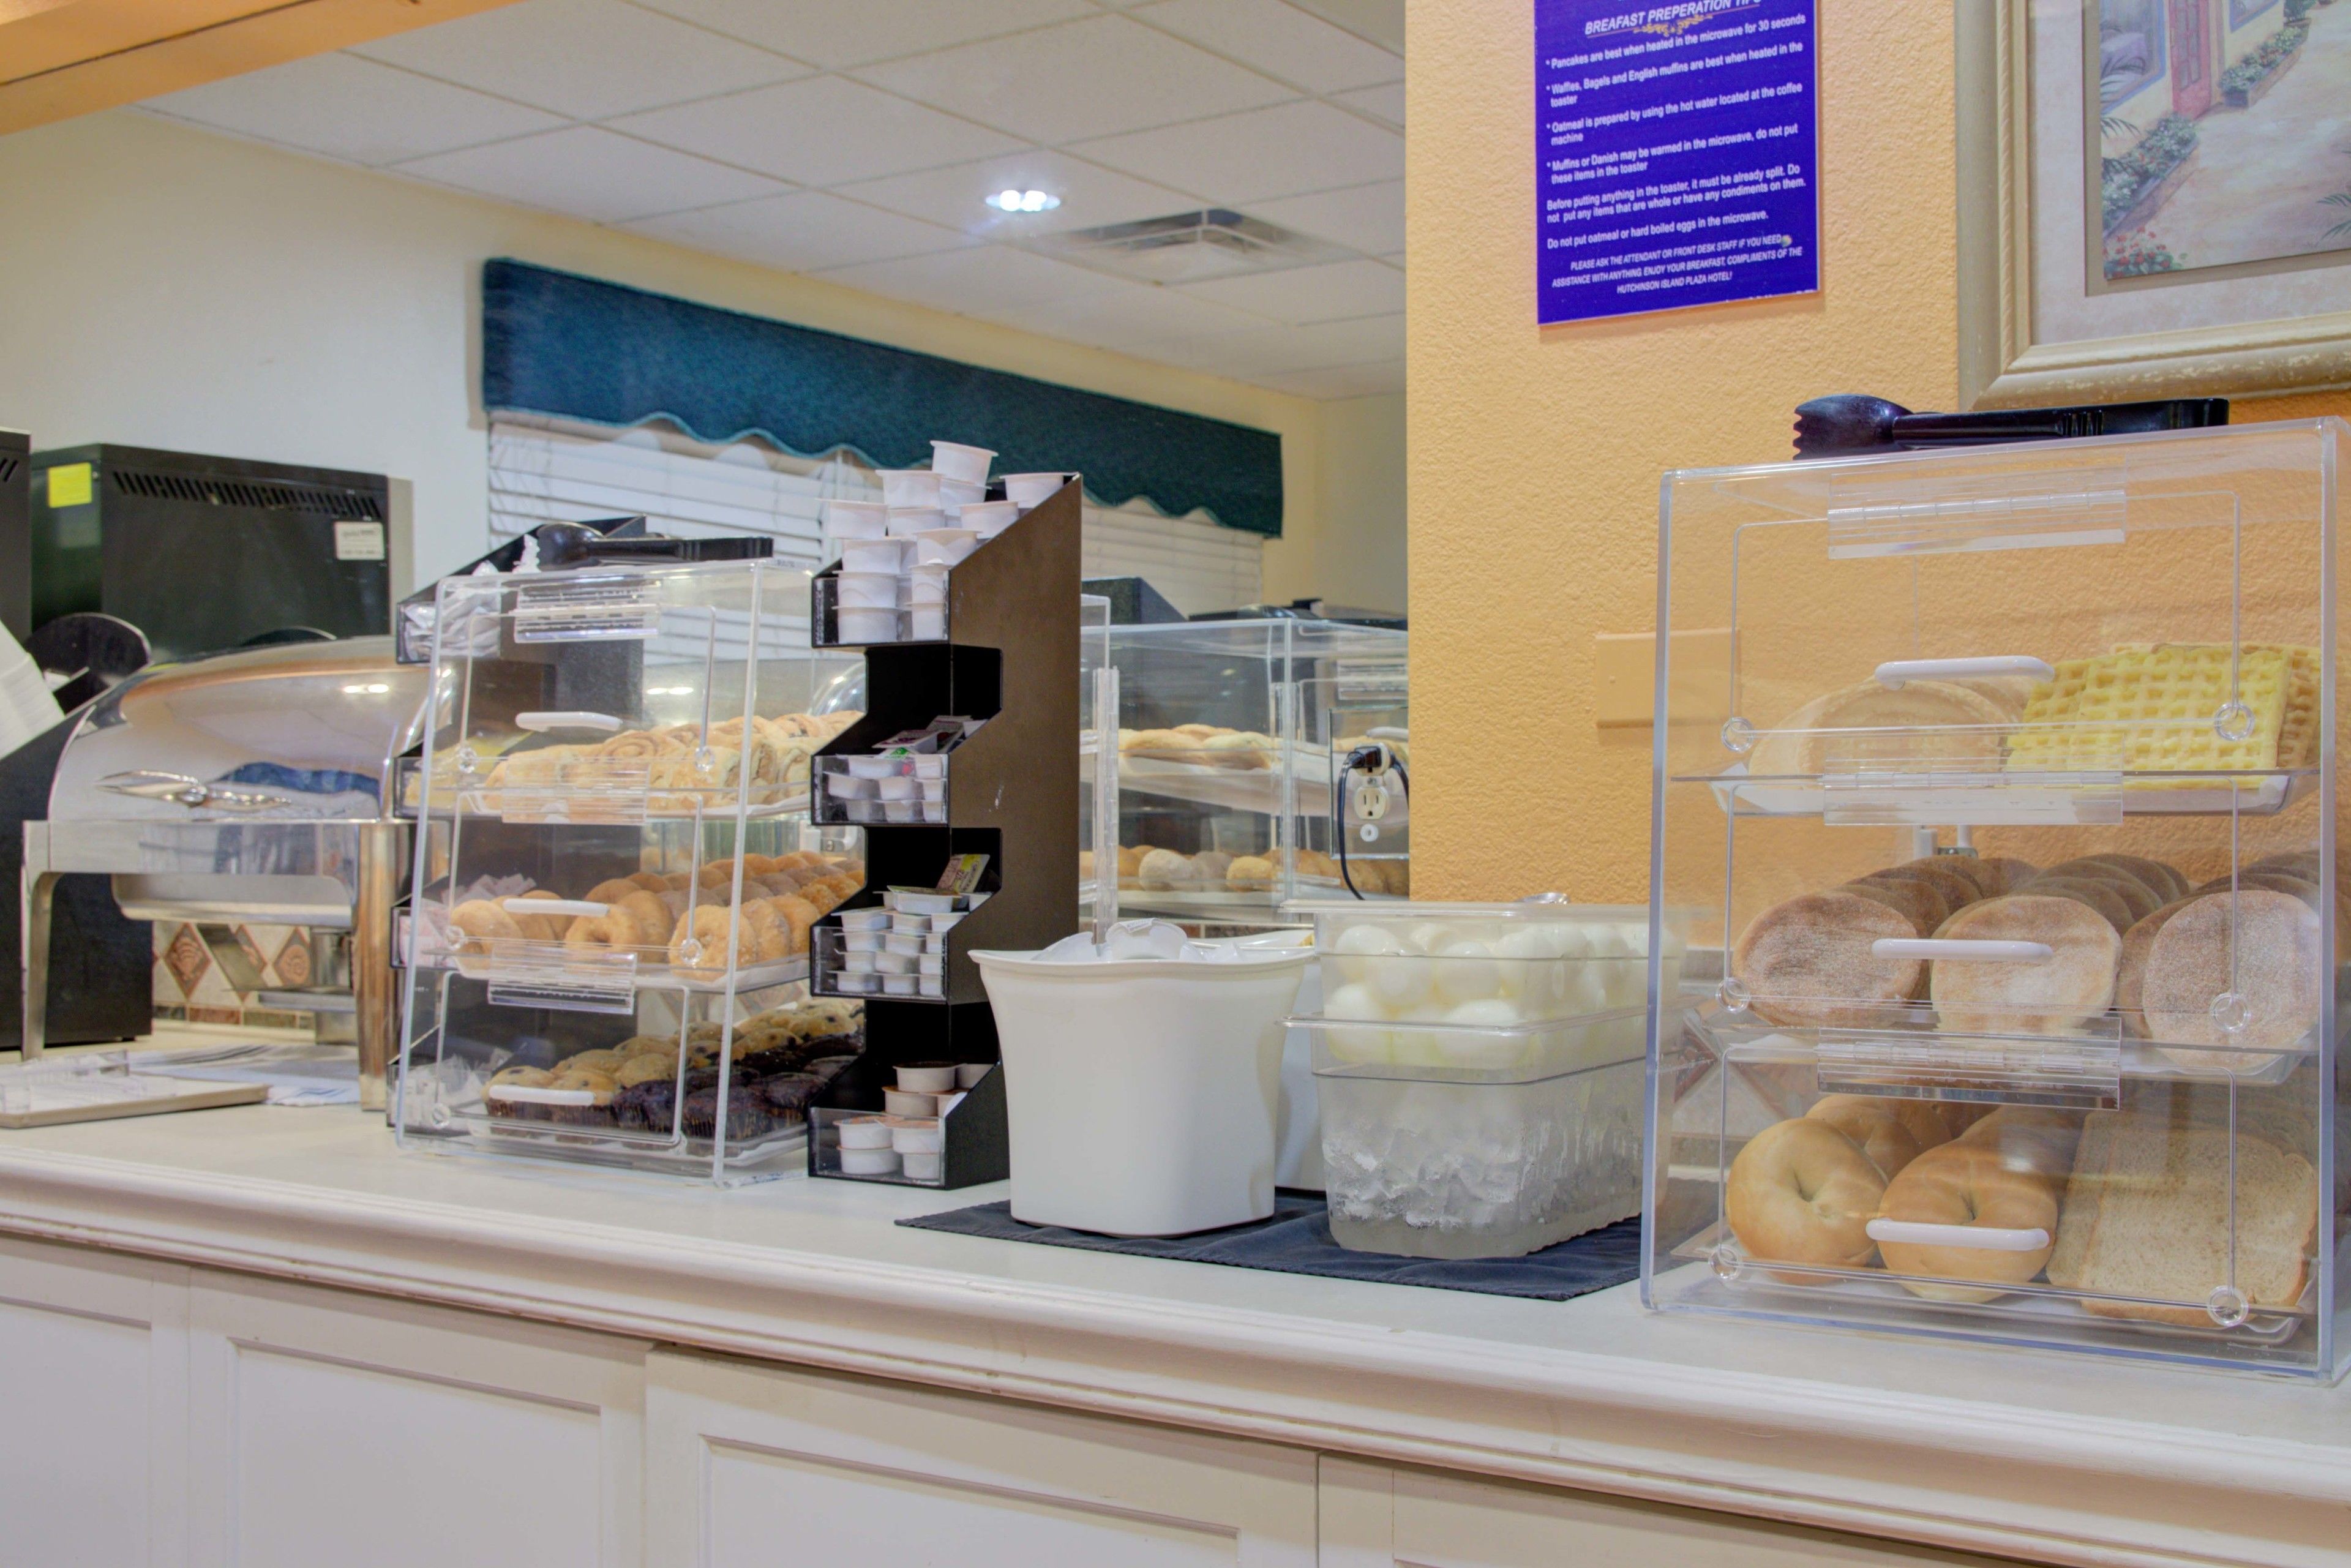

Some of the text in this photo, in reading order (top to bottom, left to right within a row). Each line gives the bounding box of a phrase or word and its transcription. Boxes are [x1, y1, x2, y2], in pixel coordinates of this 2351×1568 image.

[1584, 0, 1731, 35] BREAFAST PREPERATION
[1551, 13, 1805, 69] Pancakes are best when heated in the microwave for 30 seconds
[1583, 75, 1610, 89] Bagels
[1611, 72, 1627, 84] and
[1628, 67, 1658, 81] English
[1690, 60, 1704, 70] are
[1705, 55, 1723, 67] best
[1725, 52, 1747, 64] when
[1749, 45, 1777, 59] heated
[1779, 44, 1787, 54] in
[1788, 42, 1802, 53] the
[1550, 95, 1577, 107] toaster
[1551, 82, 1802, 133] Oatmeal is prepared by using the hot water located at the coffee
[1551, 132, 1583, 145] machine
[1581, 157, 1590, 167] or
[1591, 151, 1618, 165] Danish
[1619, 150, 1637, 161] may
[1638, 147, 1649, 158] be
[1650, 141, 1682, 156] warmed
[1683, 140, 1692, 151] in
[1693, 138, 1706, 149] the
[1755, 128, 1767, 139] do
[1768, 126, 1782, 137] not
[1783, 123, 1798, 137] put
[1547, 198, 1572, 211] Before
[1573, 194, 1600, 208] putting
[1601, 189, 1635, 203] anything
[1636, 187, 1644, 197] in
[1645, 186, 1659, 196] the
[1691, 179, 1697, 189] it
[1699, 176, 1719, 188] must
[1720, 174, 1731, 185] be
[1733, 169, 1763, 183] already
[1787, 163, 1800, 174] Do
[1551, 161, 1648, 184] these items in the toaster
[1547, 212, 1559, 223] not
[1563, 210, 1575, 223] put
[1577, 209, 1591, 220] any
[1593, 206, 1614, 216] items
[1616, 202, 1631, 213] that
[1632, 201, 1646, 211] are
[1647, 197, 1671, 208] whole
[1672, 195, 1681, 205] or
[1682, 193, 1703, 203] have
[1704, 190, 1719, 201] any
[1721, 183, 1768, 198] condiments
[1769, 181, 1780, 191] on
[1547, 238, 1559, 249] Do
[1559, 236, 1572, 247] not
[1573, 234, 1586, 247] put
[1588, 229, 1619, 243] oatmeal
[1620, 229, 1629, 239] or
[1630, 225, 1649, 237] hard
[1650, 221, 1674, 234] boiled
[1676, 220, 1696, 233] eggs
[1697, 217, 1706, 228] in
[1707, 216, 1720, 227] the
[1551, 274, 1591, 287] ASSISTANCE
[1643, 264, 1665, 276] ENJOY
[1666, 261, 1686, 272] YOUR
[1727, 250, 1776, 265] COMPLIMENTS
[1777, 248, 1787, 258] OF
[1788, 246, 1802, 256] THE
[1570, 258, 1595, 270] PLEASE
[1595, 257, 1608, 267] ASK
[1610, 255, 1622, 264] THE
[1622, 250, 1661, 263] ATTENDANT
[1662, 248, 1673, 258] OR
[1673, 245, 1696, 257] FRONT
[1697, 243, 1715, 253] DESK
[1716, 239, 1738, 251] STAFF
[1738, 238, 1745, 248] IF
[1746, 236, 1761, 247] YOU
[1616, 280, 1660, 293] HUTCHINSON
[1660, 277, 1684, 288] ISLAND
[1685, 274, 1706, 285] PLAZA
